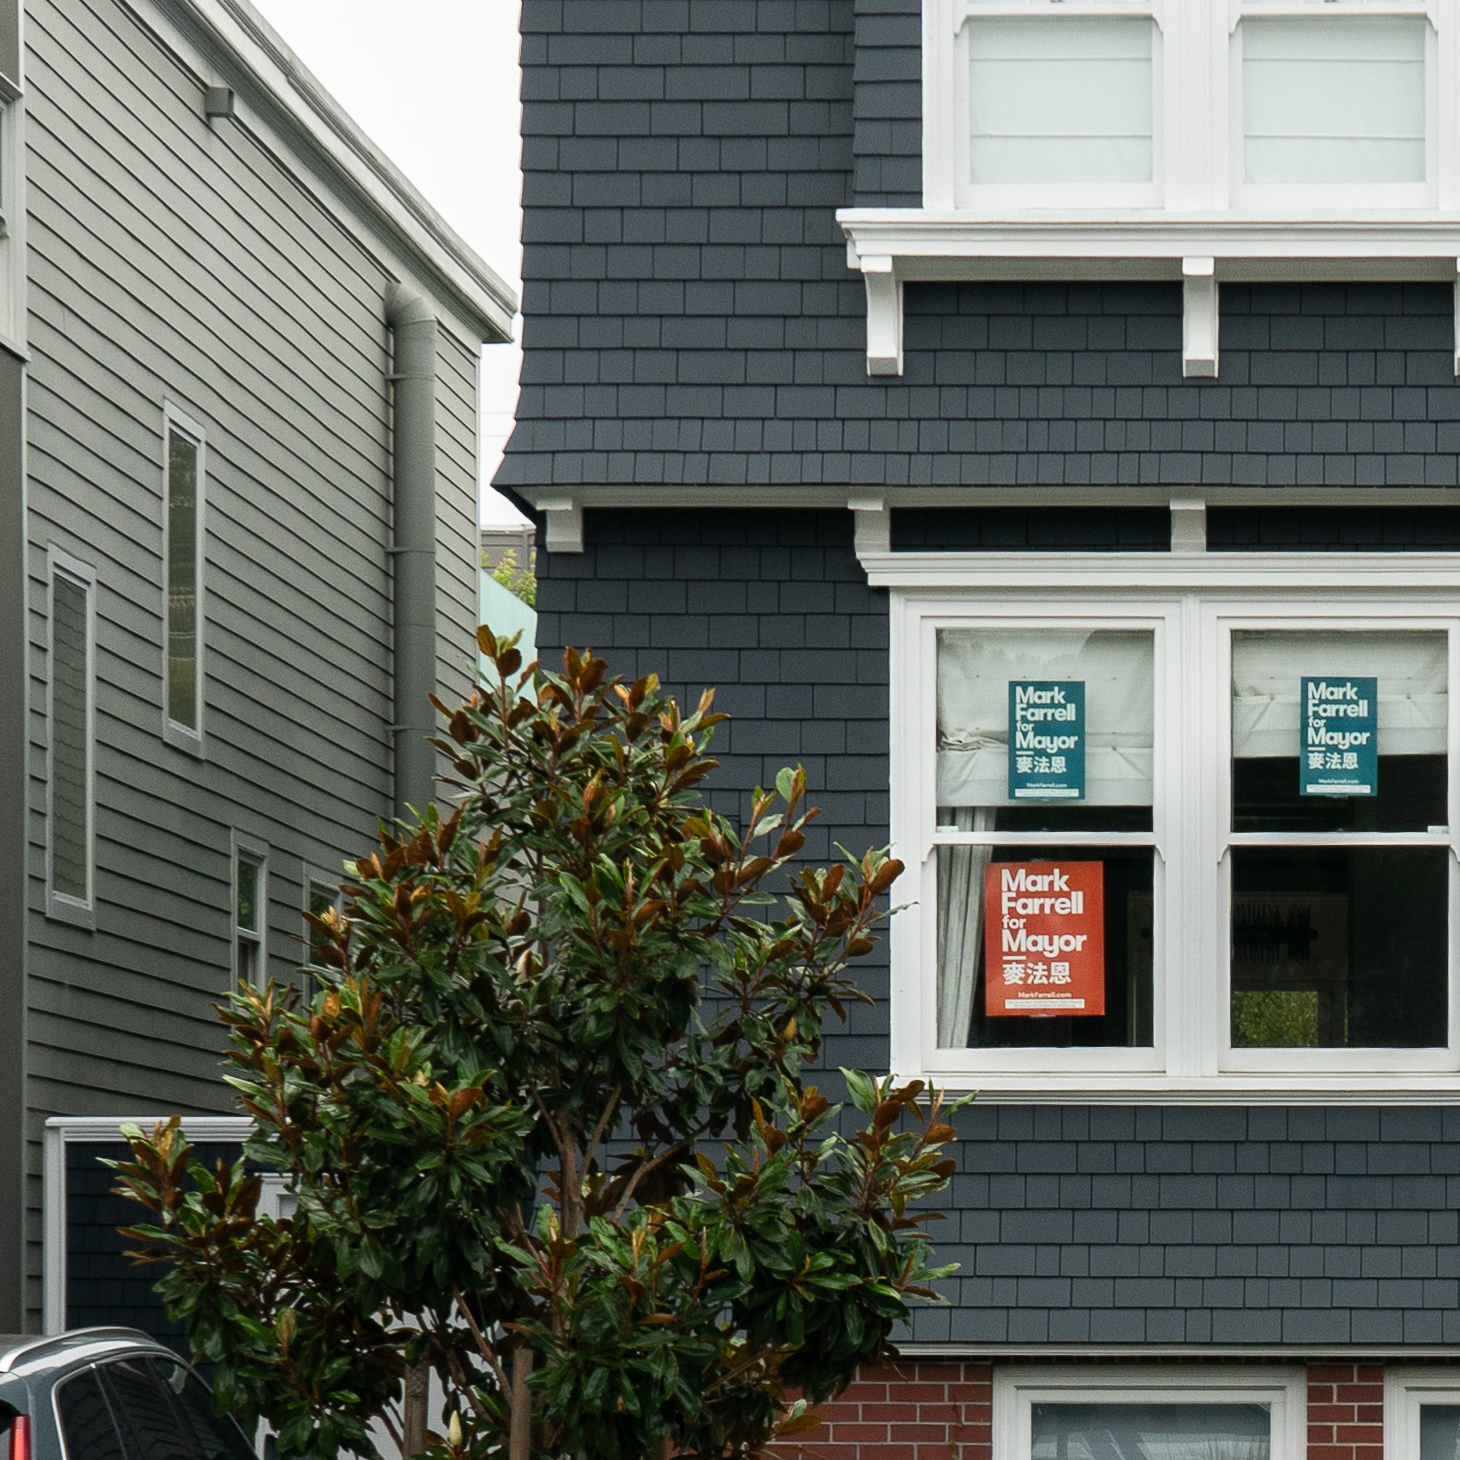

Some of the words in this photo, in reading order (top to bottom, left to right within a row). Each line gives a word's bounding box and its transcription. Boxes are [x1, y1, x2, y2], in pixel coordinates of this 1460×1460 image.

[1016, 686, 1066, 704] Mark
[1307, 682, 1358, 700] Mark
[1016, 703, 1076, 721] Farrell
[1307, 699, 1368, 717] Farrell
[1016, 721, 1034, 732] for
[1308, 716, 1326, 728] for
[1016, 731, 1078, 754] Mayor
[1307, 727, 1370, 750] Mayor
[1016, 756, 1067, 774] 麥法恩
[1307, 752, 1358, 770] 麥法恩
[1001, 868, 1069, 892] Mark
[1001, 891, 1084, 915] Farrell
[1002, 914, 1027, 930] for
[1002, 929, 1087, 958] Mayor
[1002, 961, 1072, 985] 麥法恩
